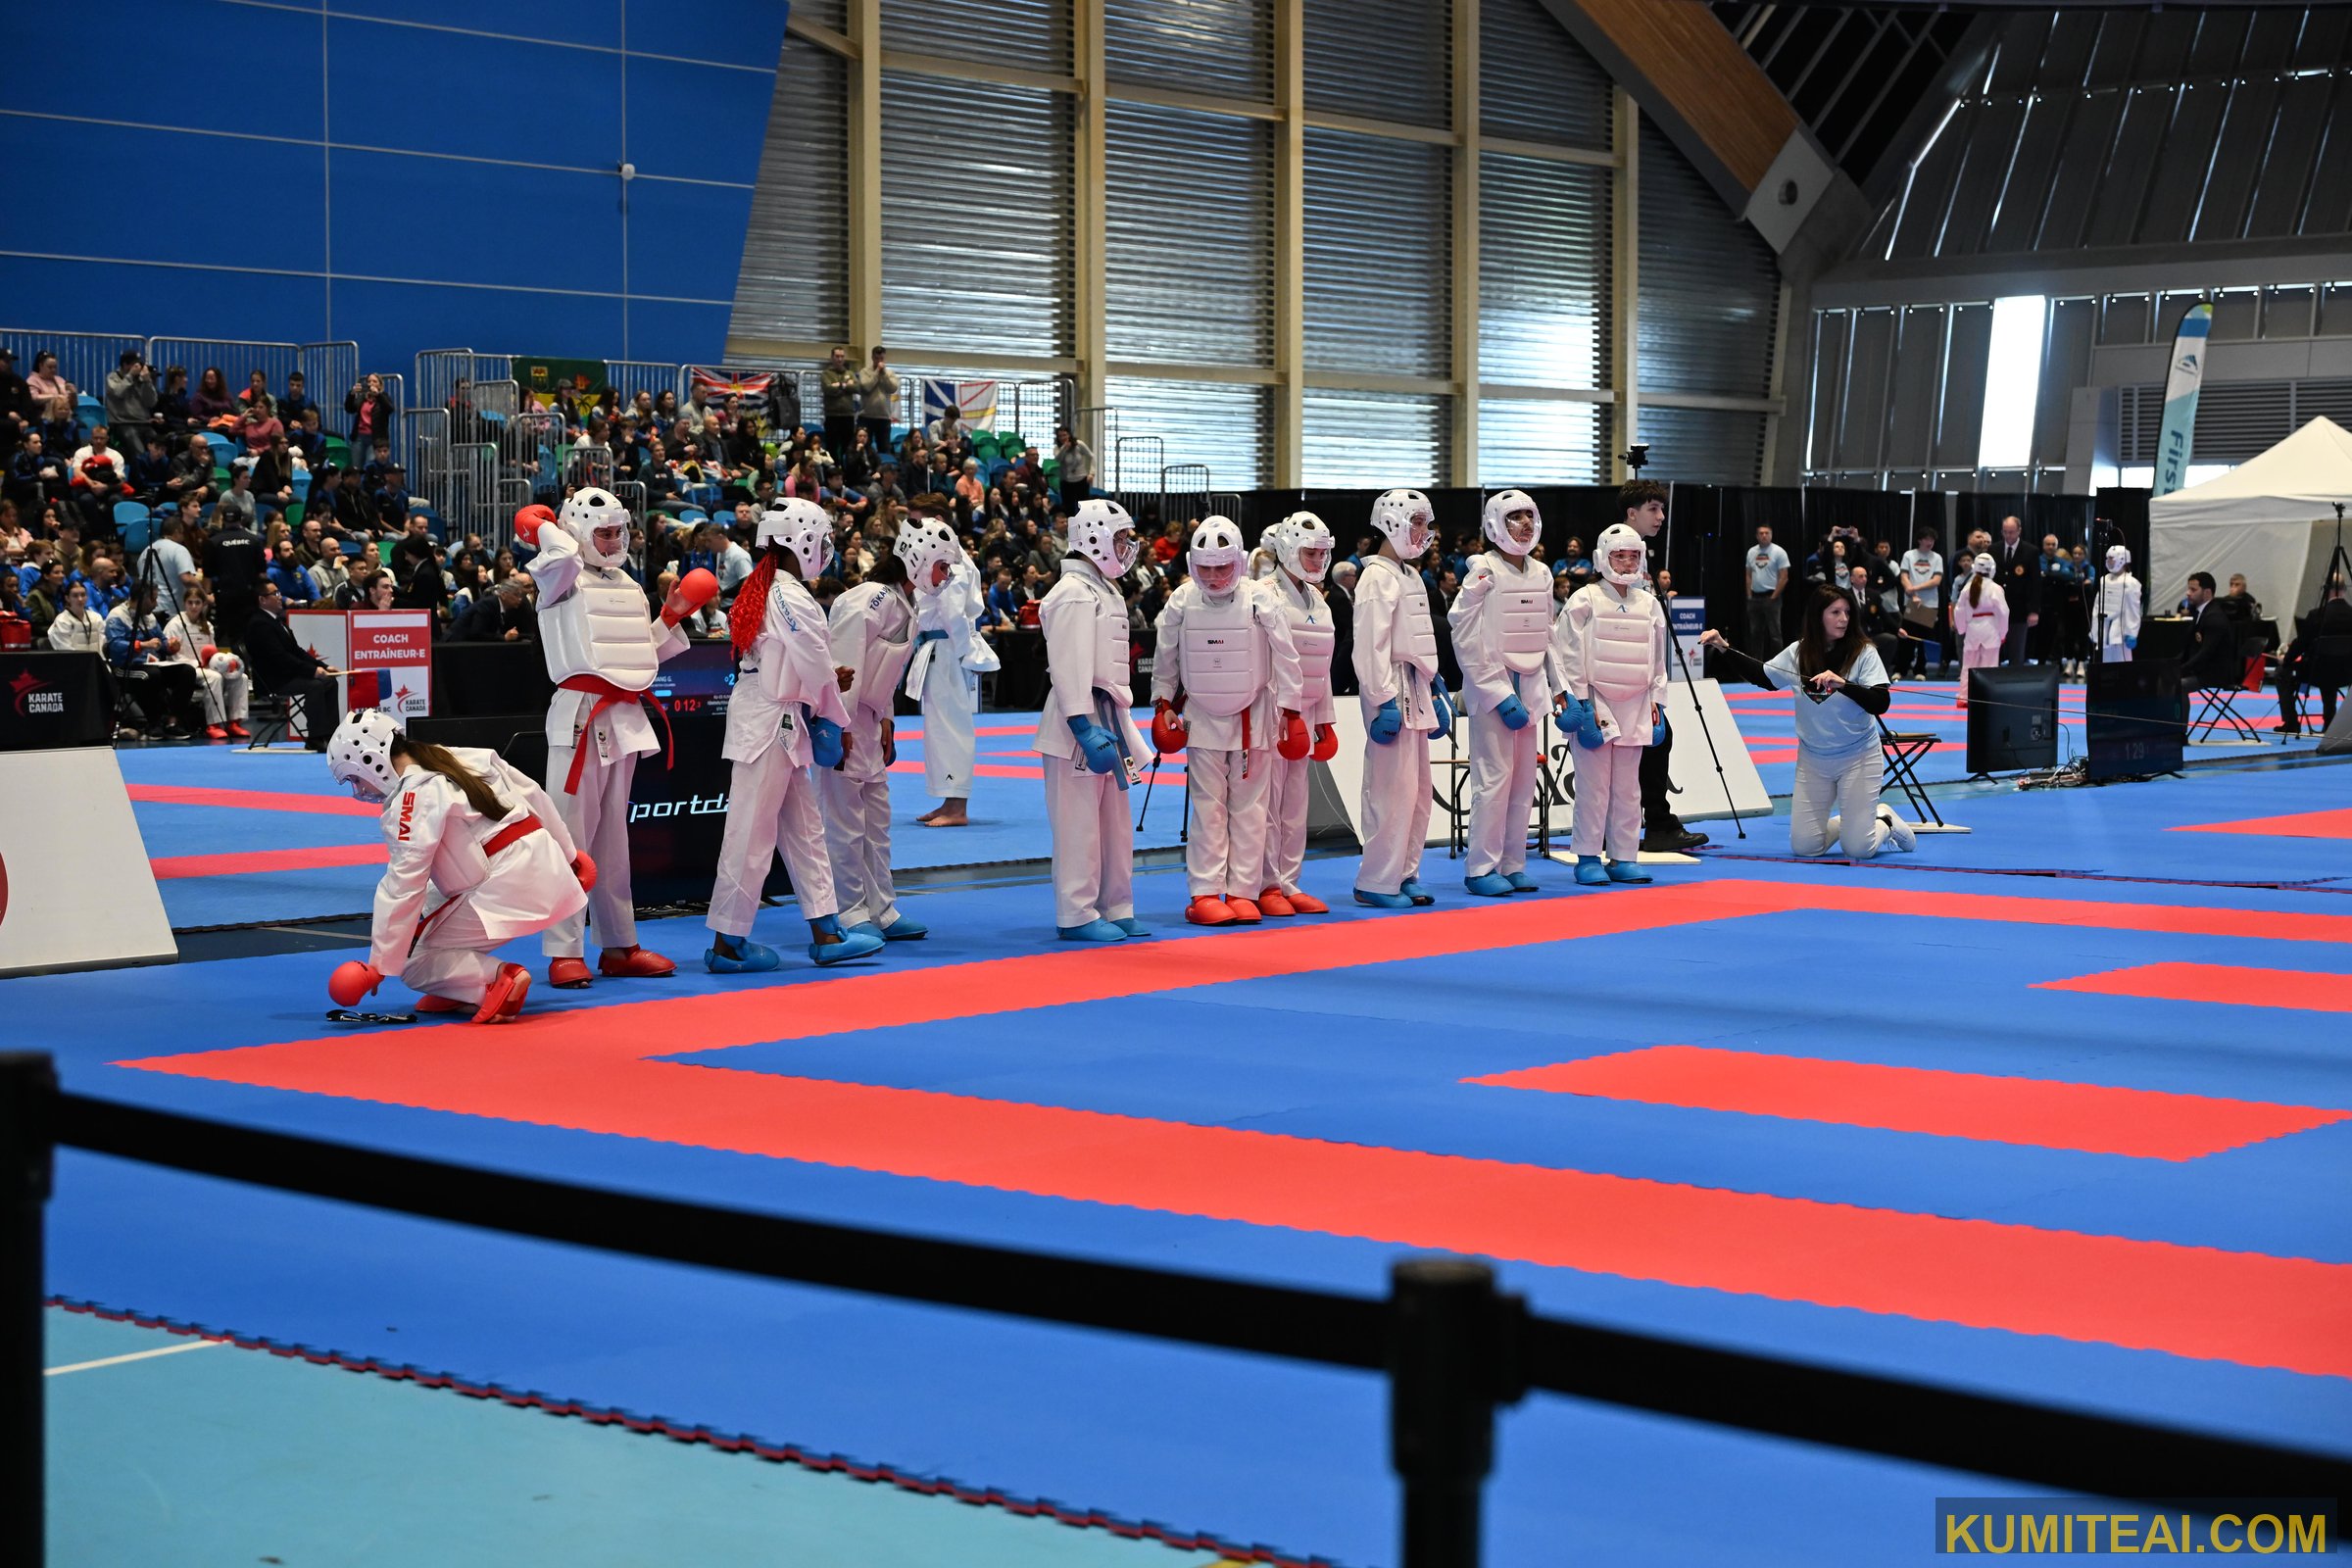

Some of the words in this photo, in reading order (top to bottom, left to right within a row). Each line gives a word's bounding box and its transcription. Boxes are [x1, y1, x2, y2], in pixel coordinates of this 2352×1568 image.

[373, 634, 409, 643] COACH
[28, 693, 63, 703] KARATE
[29, 703, 64, 713] CANADA
[628, 793, 729, 823] portd
[398, 792, 416, 841] SMAI
